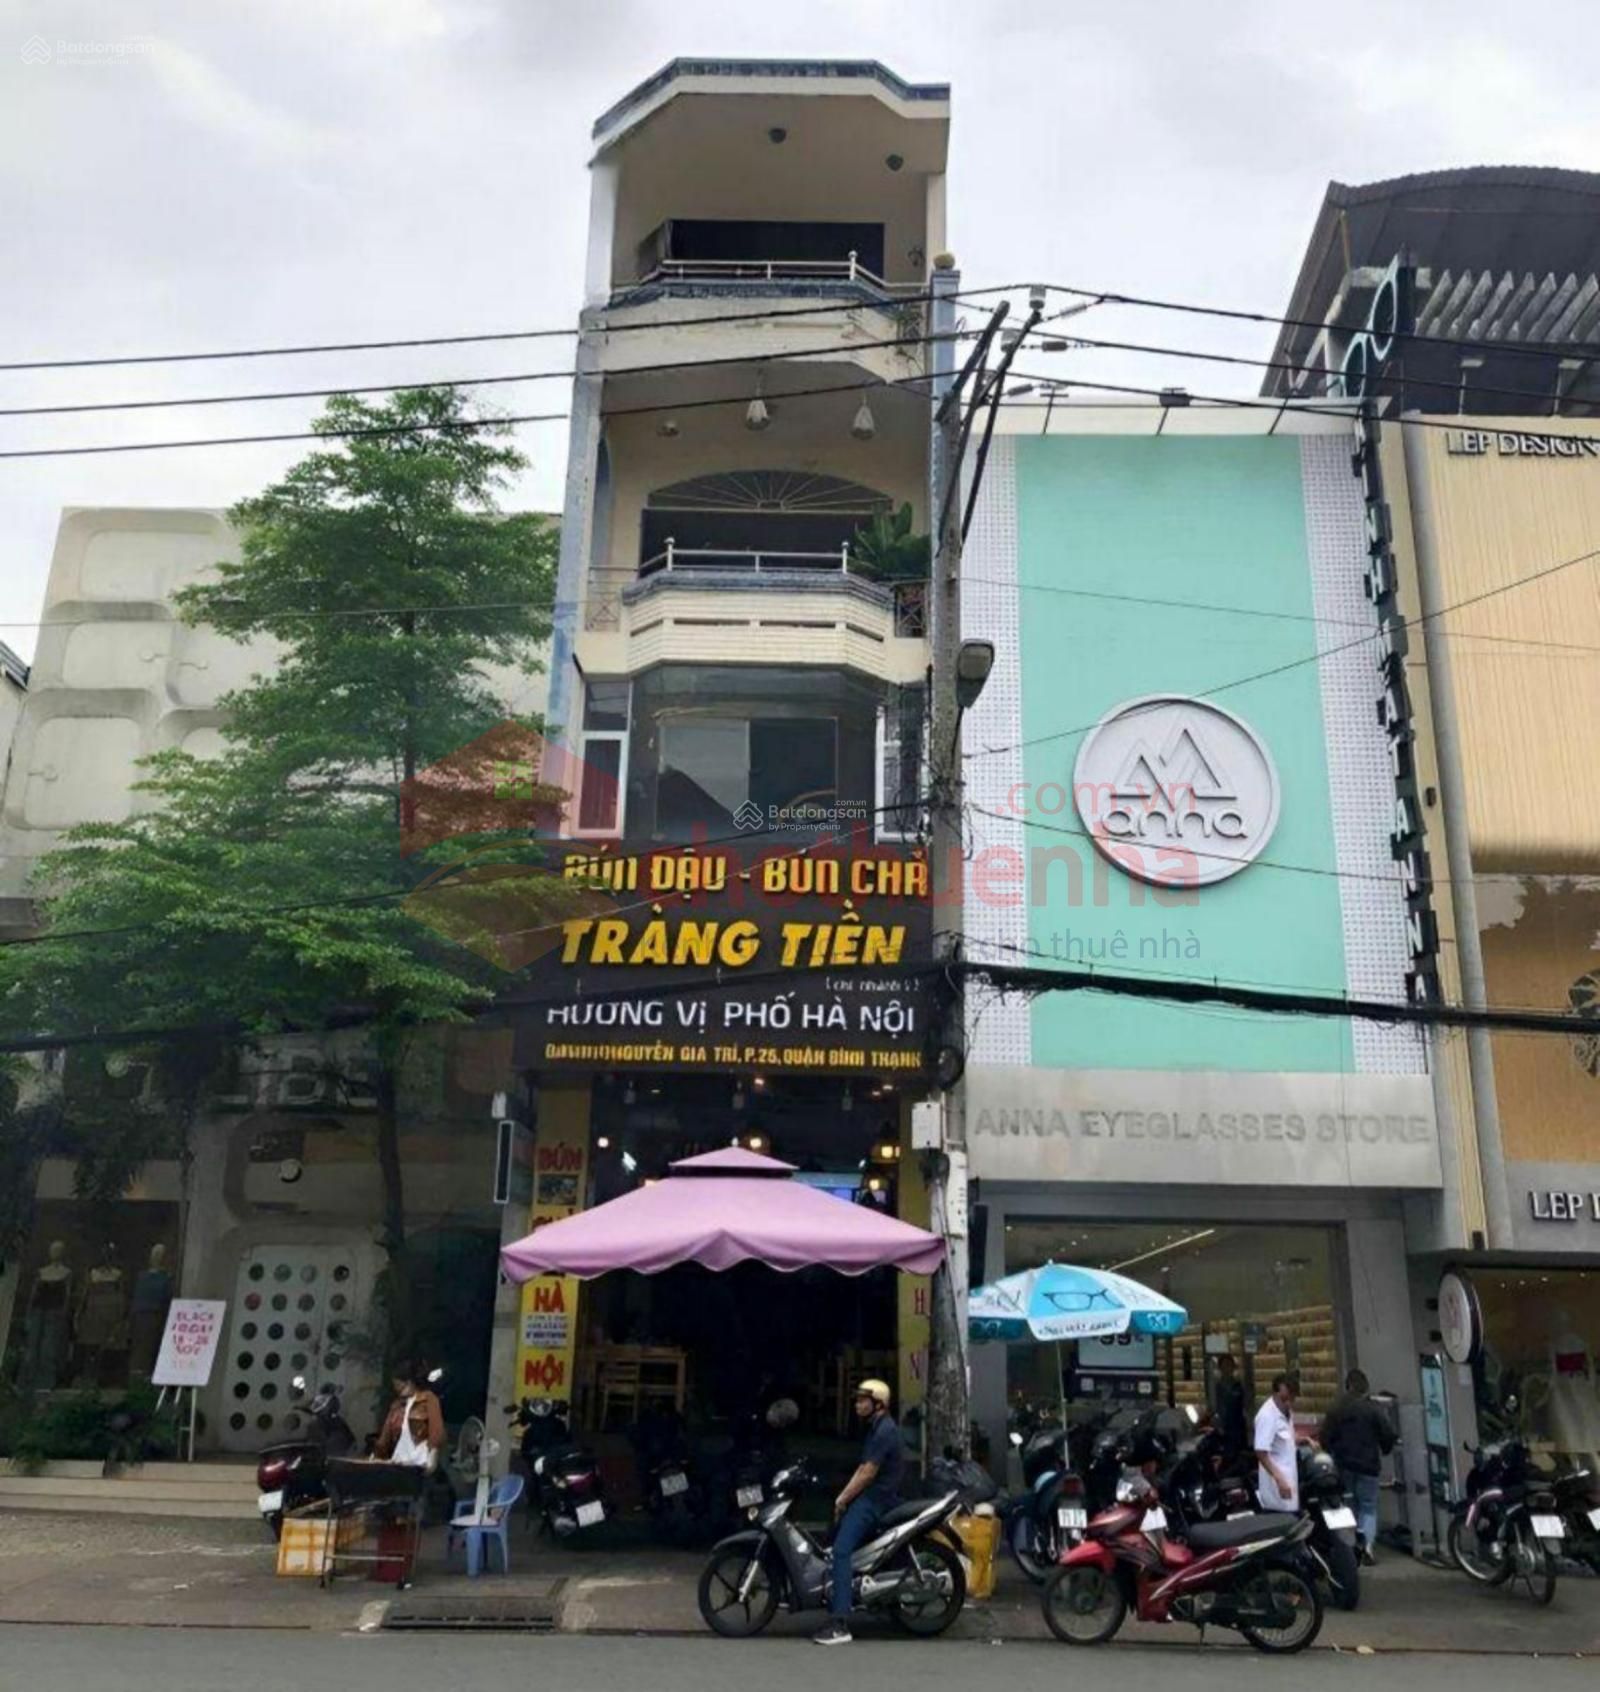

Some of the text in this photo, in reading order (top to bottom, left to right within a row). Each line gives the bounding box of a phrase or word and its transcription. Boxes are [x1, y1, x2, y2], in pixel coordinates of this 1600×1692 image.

[1446, 431, 1491, 454] LEP
[651, 847, 726, 900] ĐẬU
[763, 848, 839, 894] BÚN
[781, 899, 906, 967] TIỀN
[723, 991, 796, 1029] PHỐ
[801, 996, 848, 1031] HÀ
[859, 1000, 914, 1040] NỘI
[680, 1046, 706, 1063] GIA
[974, 1109, 1431, 1144] ANNA EYEGLASSES STORE
[1529, 1191, 1583, 1219] LEP
[534, 1281, 565, 1312] HÀ
[524, 1354, 564, 1391] NỘI
